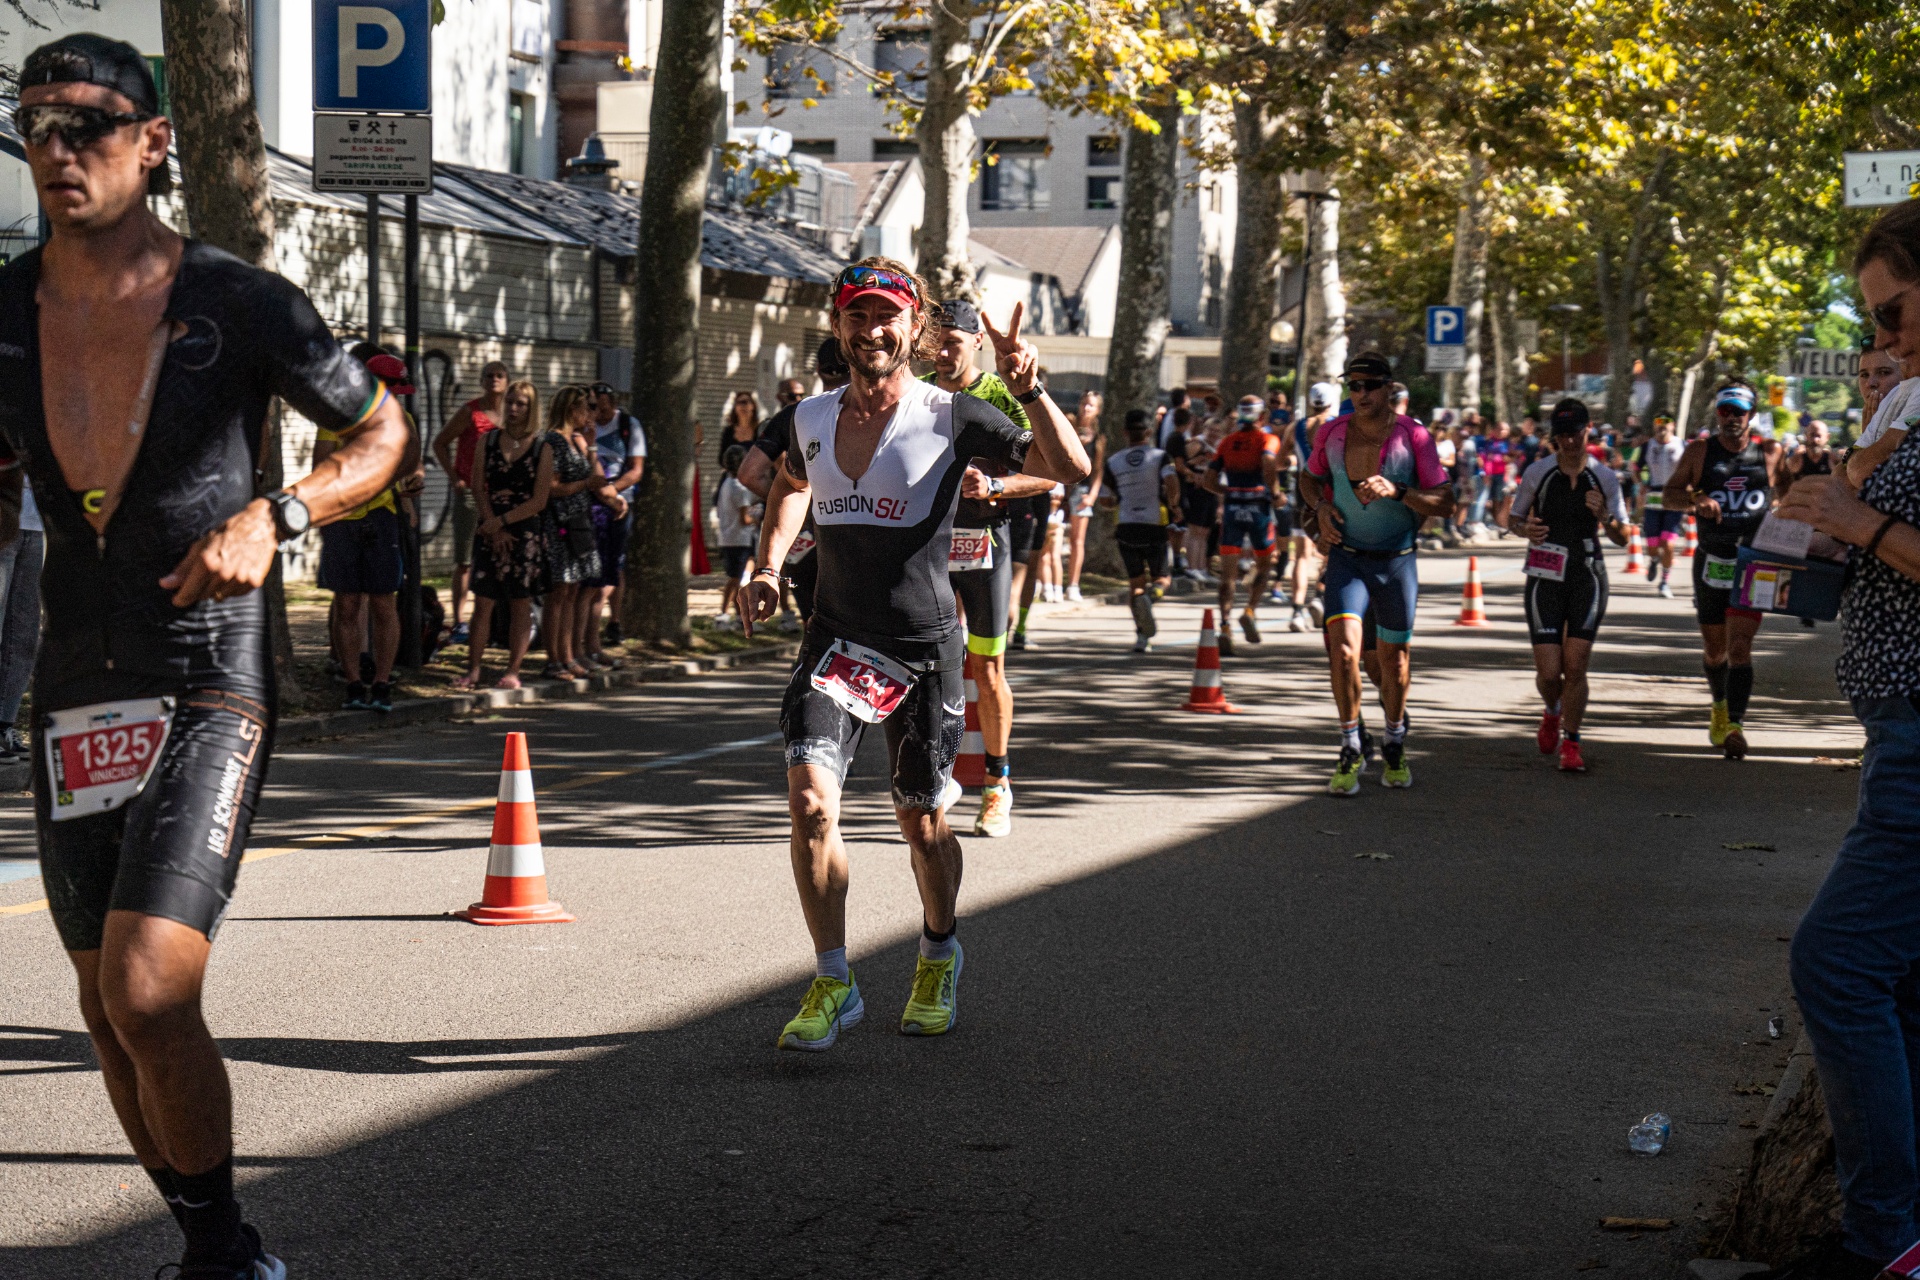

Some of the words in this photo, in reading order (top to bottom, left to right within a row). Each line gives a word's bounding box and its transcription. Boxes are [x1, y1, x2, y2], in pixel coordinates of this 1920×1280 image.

[338, 6, 405, 97] P
[1434, 310, 1458, 341] P
[1789, 351, 1859, 376] WELCO
[1709, 489, 1765, 510] evo
[845, 681, 875, 704] MICHAL
[850, 665, 889, 696] 154
[77, 726, 150, 770] 1325
[88, 764, 138, 784] VINICIUS
[207, 828, 227, 855] LEO
